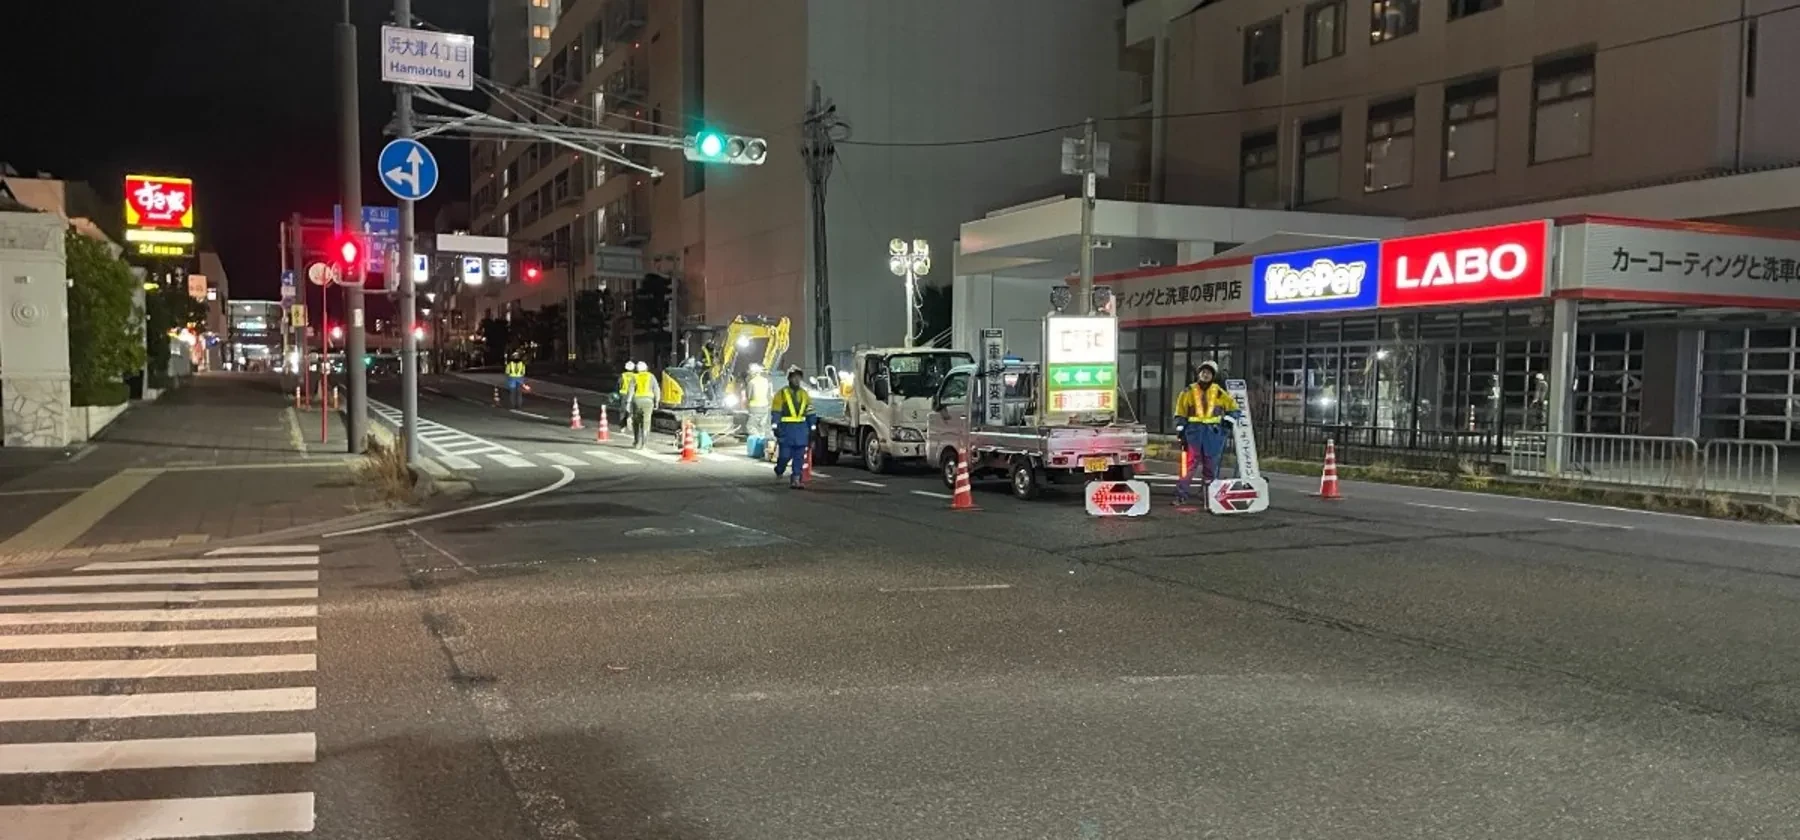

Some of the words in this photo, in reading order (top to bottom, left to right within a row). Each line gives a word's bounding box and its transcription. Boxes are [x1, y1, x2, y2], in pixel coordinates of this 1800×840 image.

[388, 36, 468, 63] 浜大津4丁目
[390, 61, 451, 79] Hamaotsu
[457, 68, 465, 80] 4
[1266, 259, 1366, 303] KeePer
[1395, 244, 1529, 289] LABO
[1612, 246, 1800, 283] カーコーティングと洗車
